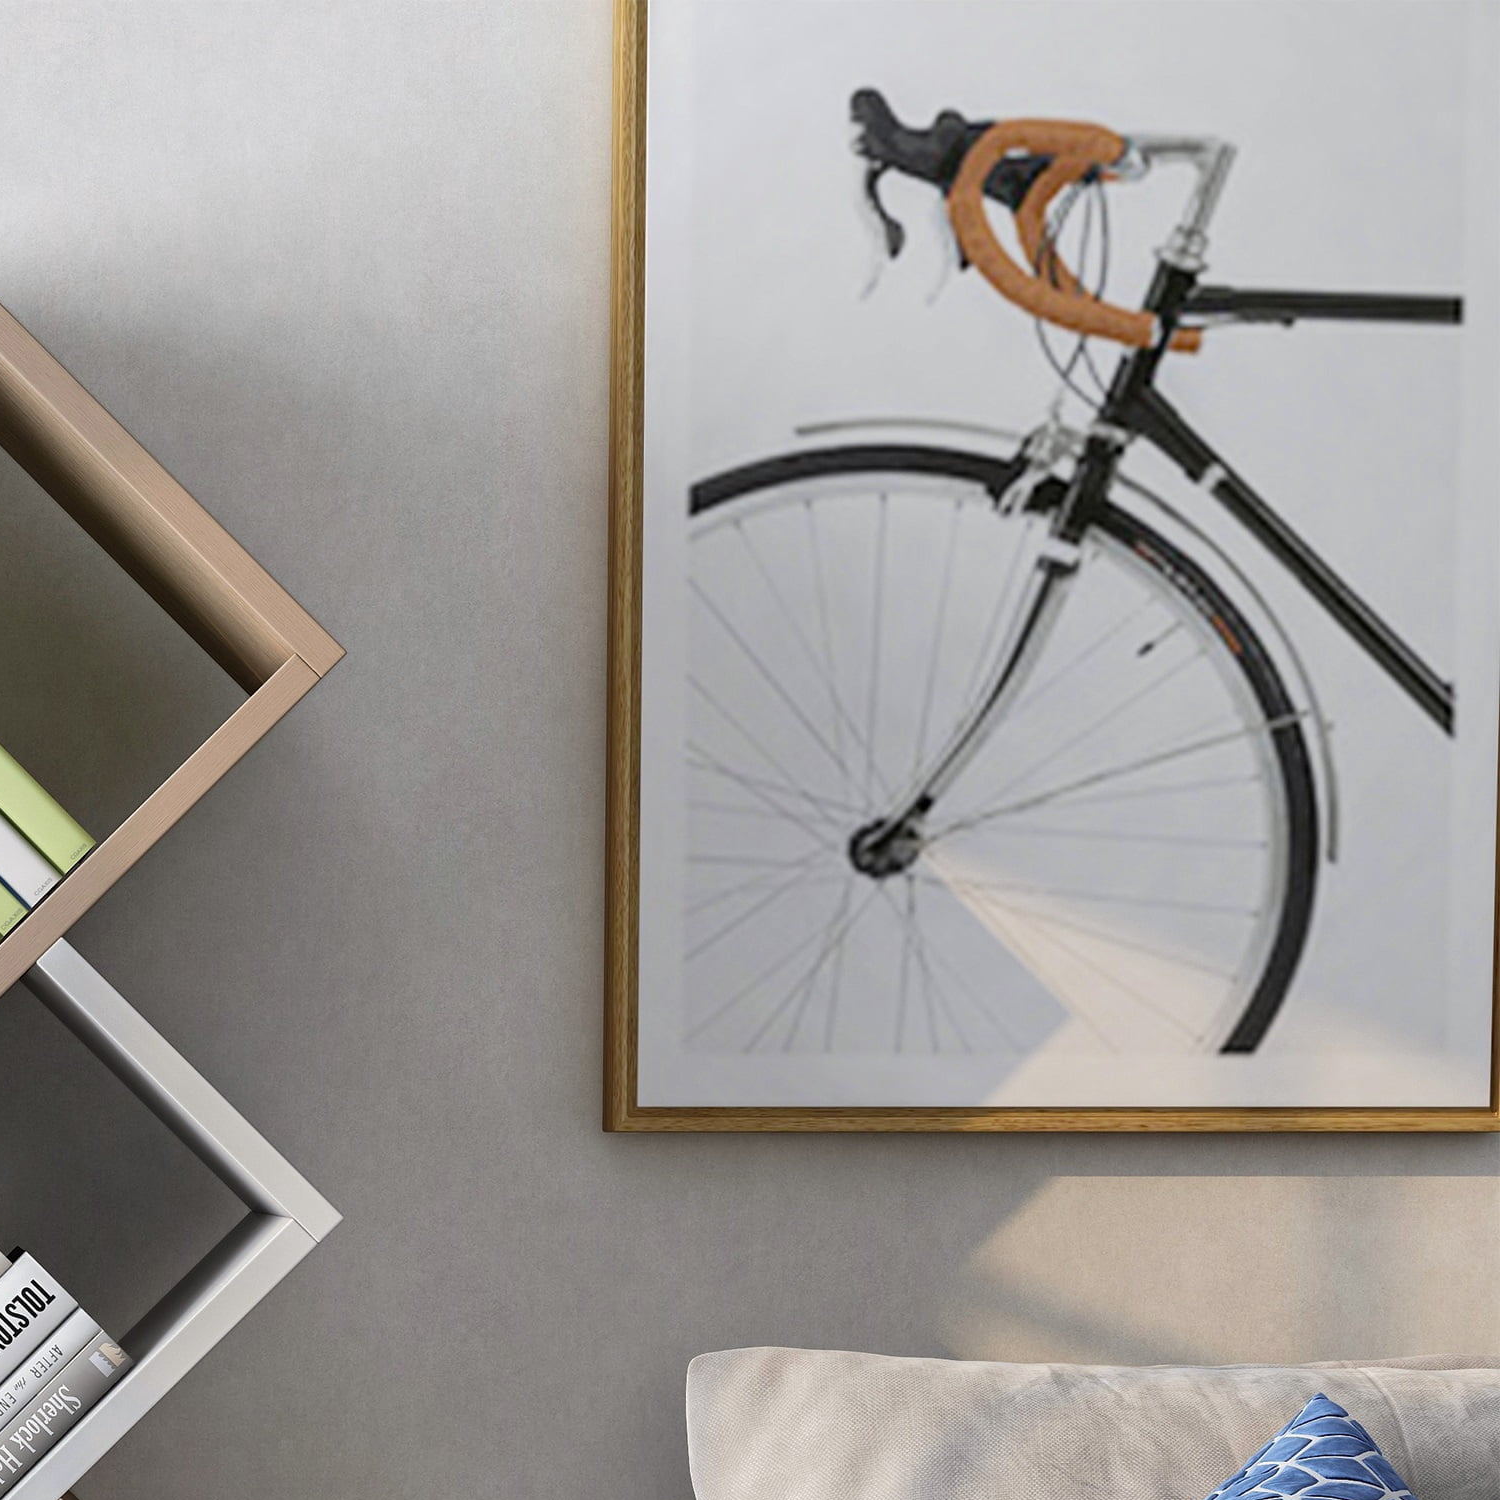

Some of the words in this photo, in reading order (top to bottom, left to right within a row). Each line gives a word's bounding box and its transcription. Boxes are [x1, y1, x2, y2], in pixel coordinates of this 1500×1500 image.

[30, 1344, 63, 1379] AFTER
[14, 1376, 27, 1391] the
[9, 1384, 82, 1454] Sherlock
